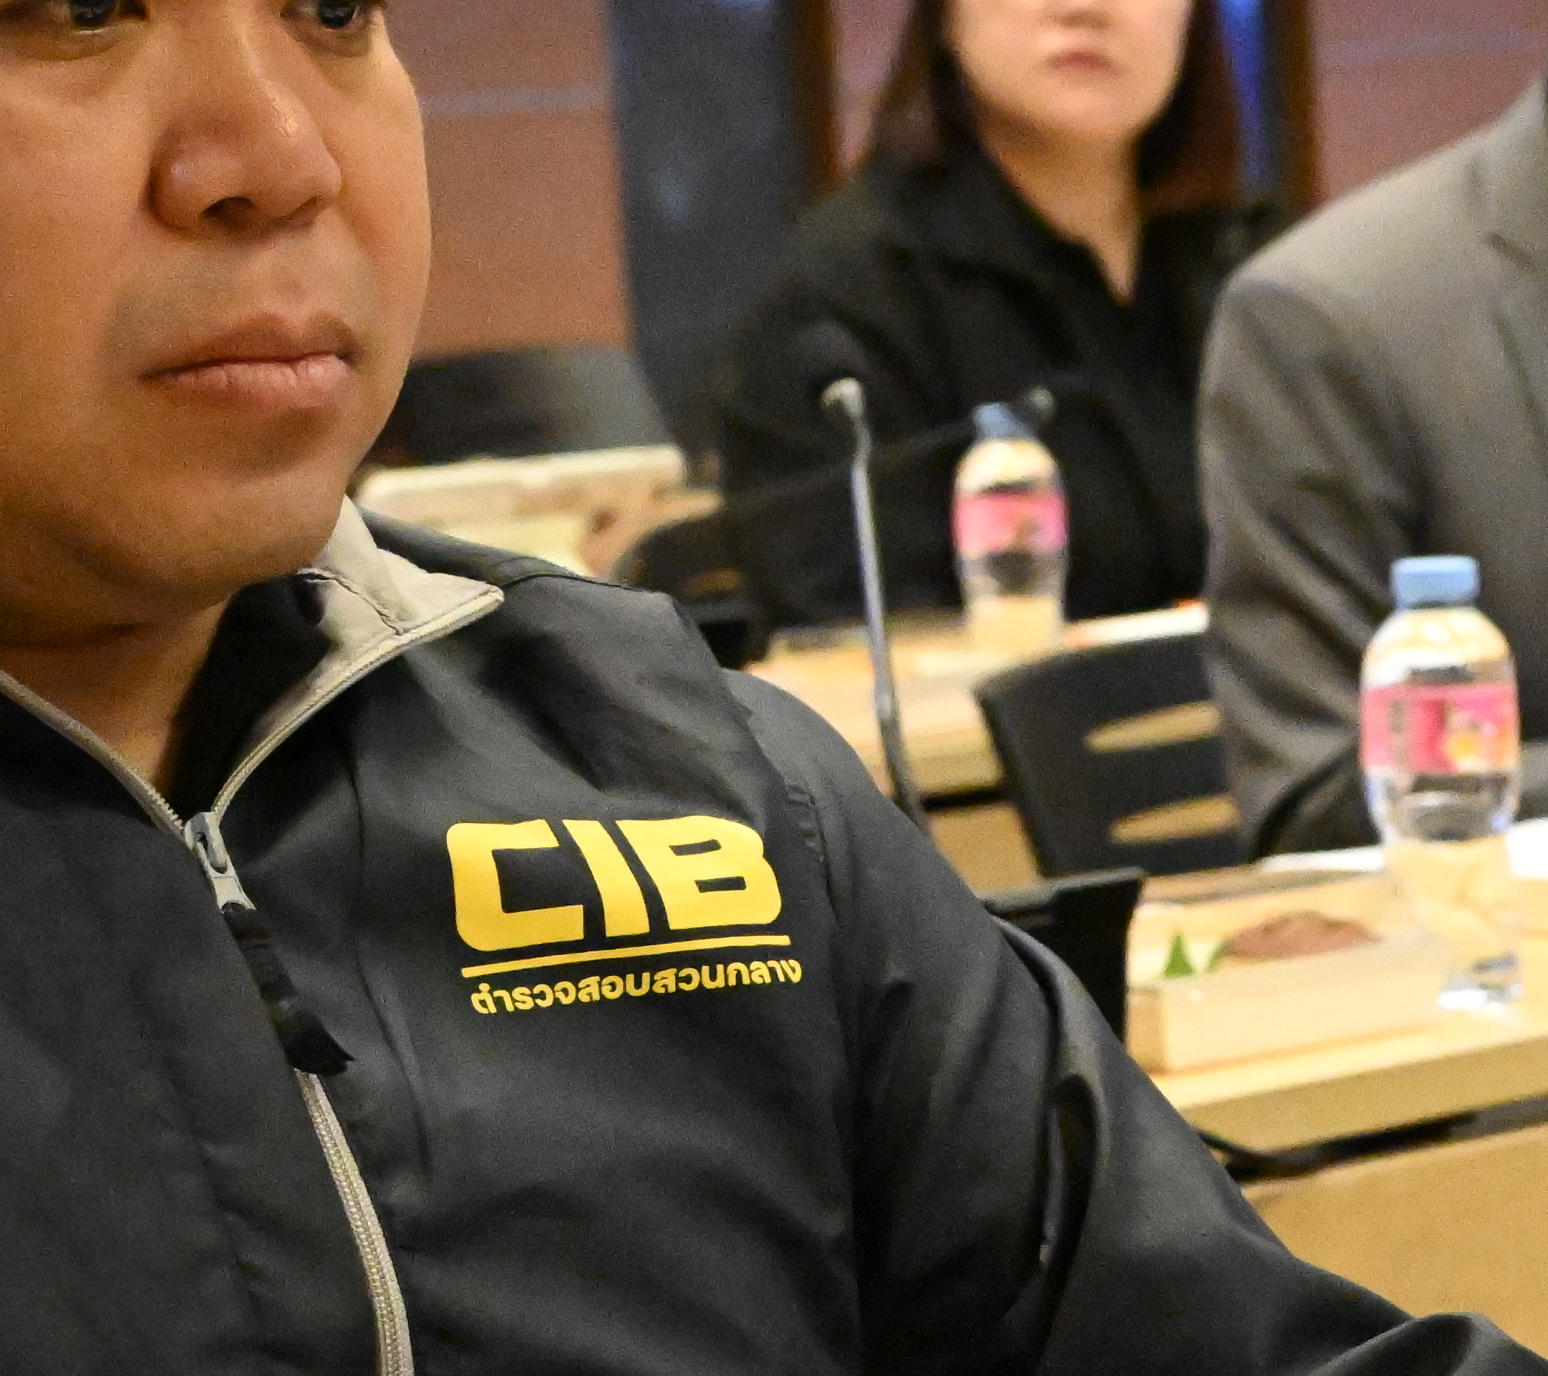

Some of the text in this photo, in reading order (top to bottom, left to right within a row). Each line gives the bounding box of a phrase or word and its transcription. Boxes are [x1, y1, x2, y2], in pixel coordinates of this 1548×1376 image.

[446, 815, 782, 952] CIB
[470, 958, 803, 1015] ตำรวจสอบสวนกลาง
